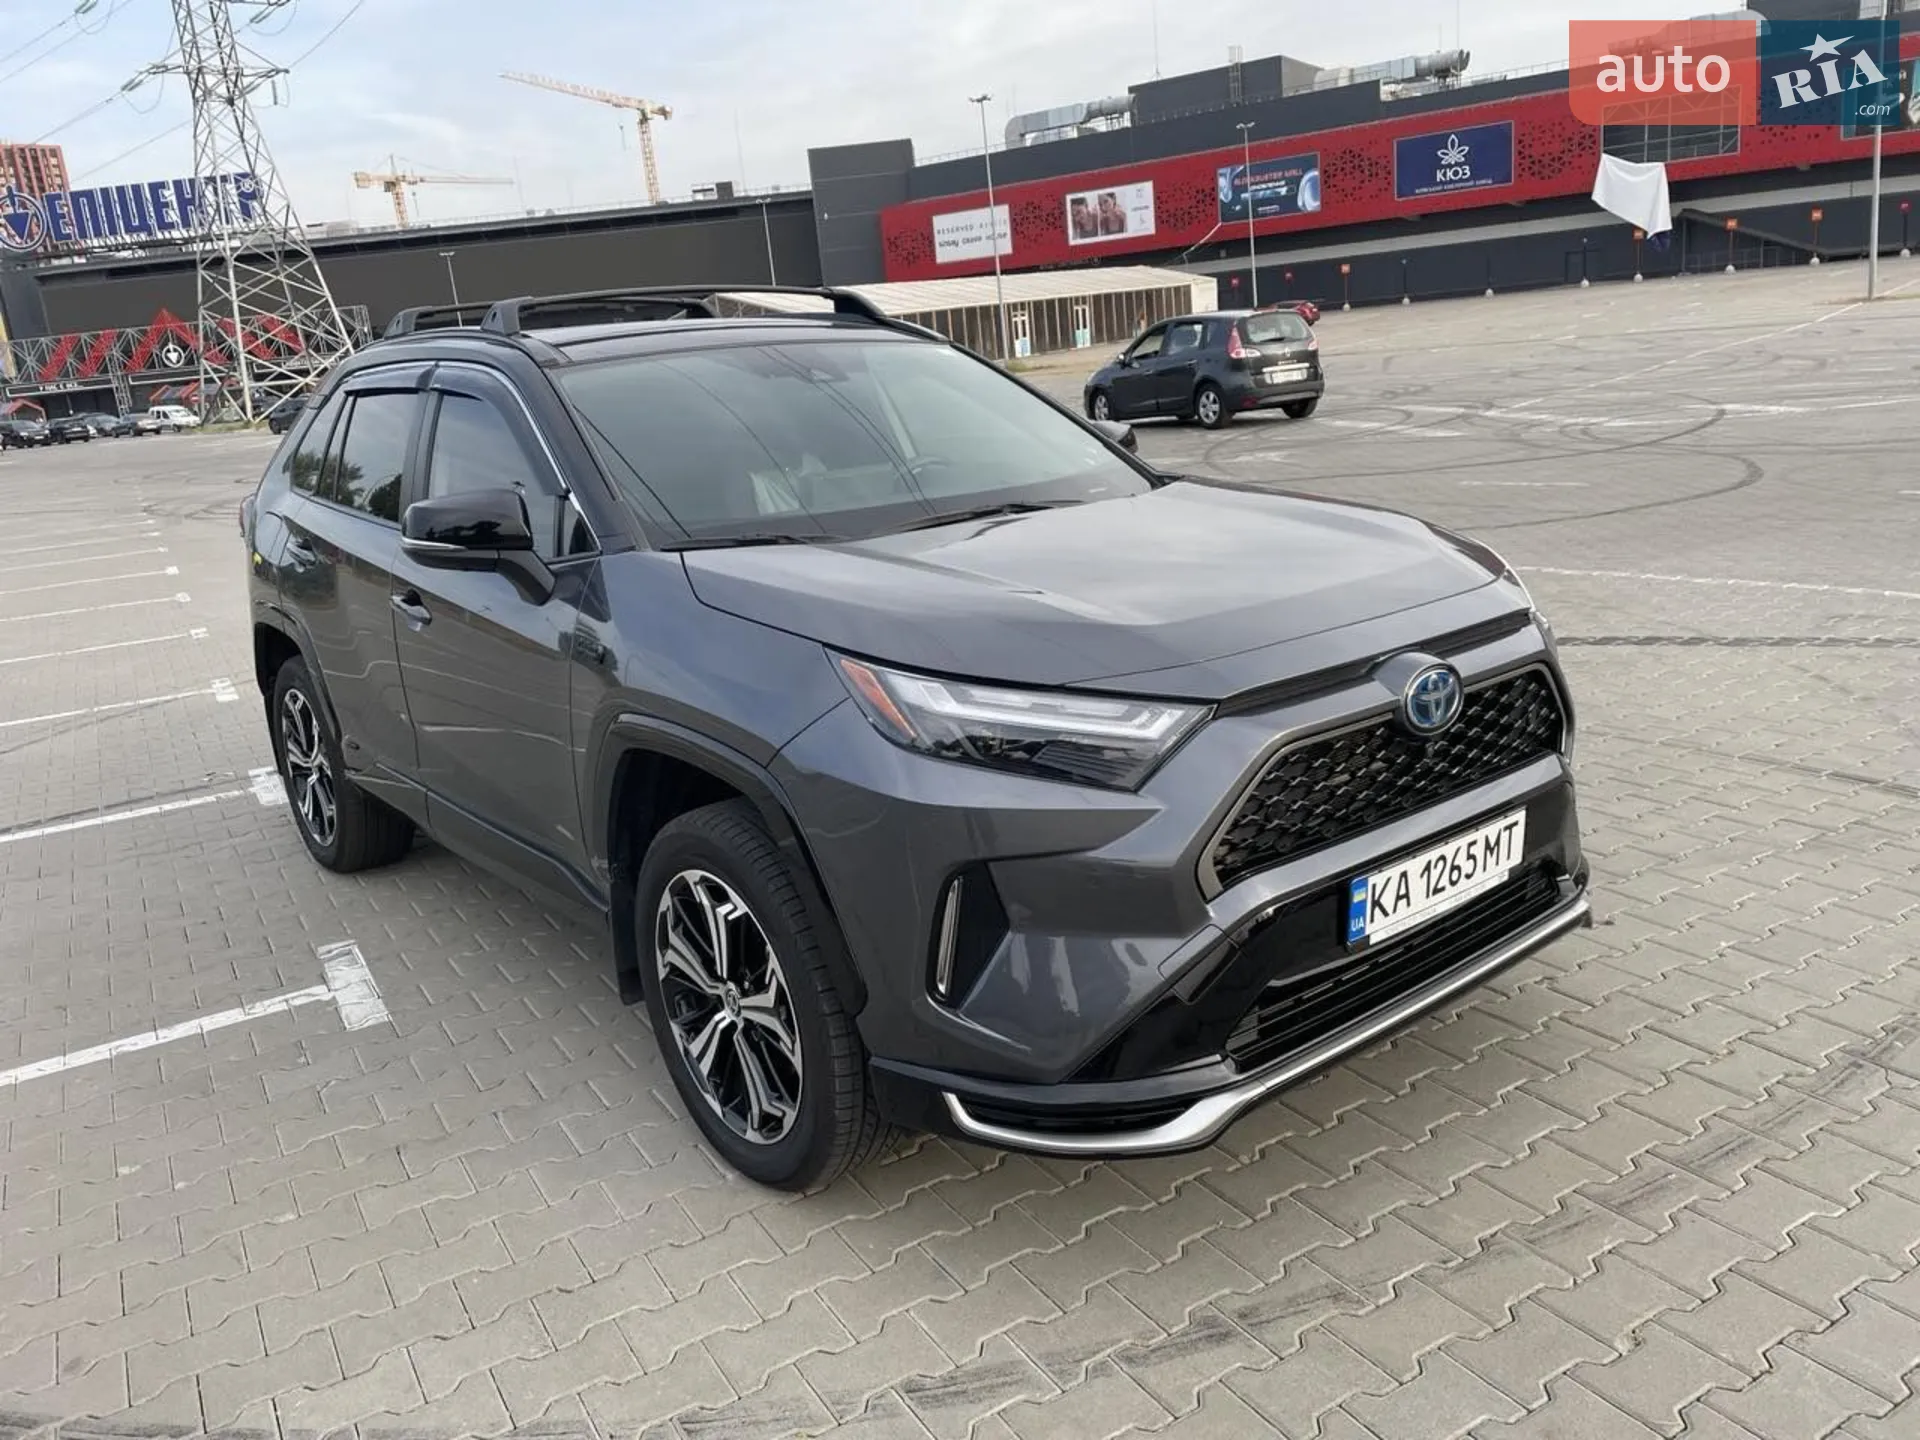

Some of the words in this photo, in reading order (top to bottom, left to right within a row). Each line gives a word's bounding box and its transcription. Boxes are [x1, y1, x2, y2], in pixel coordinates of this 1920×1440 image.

[1436, 165, 1471, 182] КЮЗ
[1350, 917, 1365, 932] UA
[1369, 868, 1411, 924] KA
